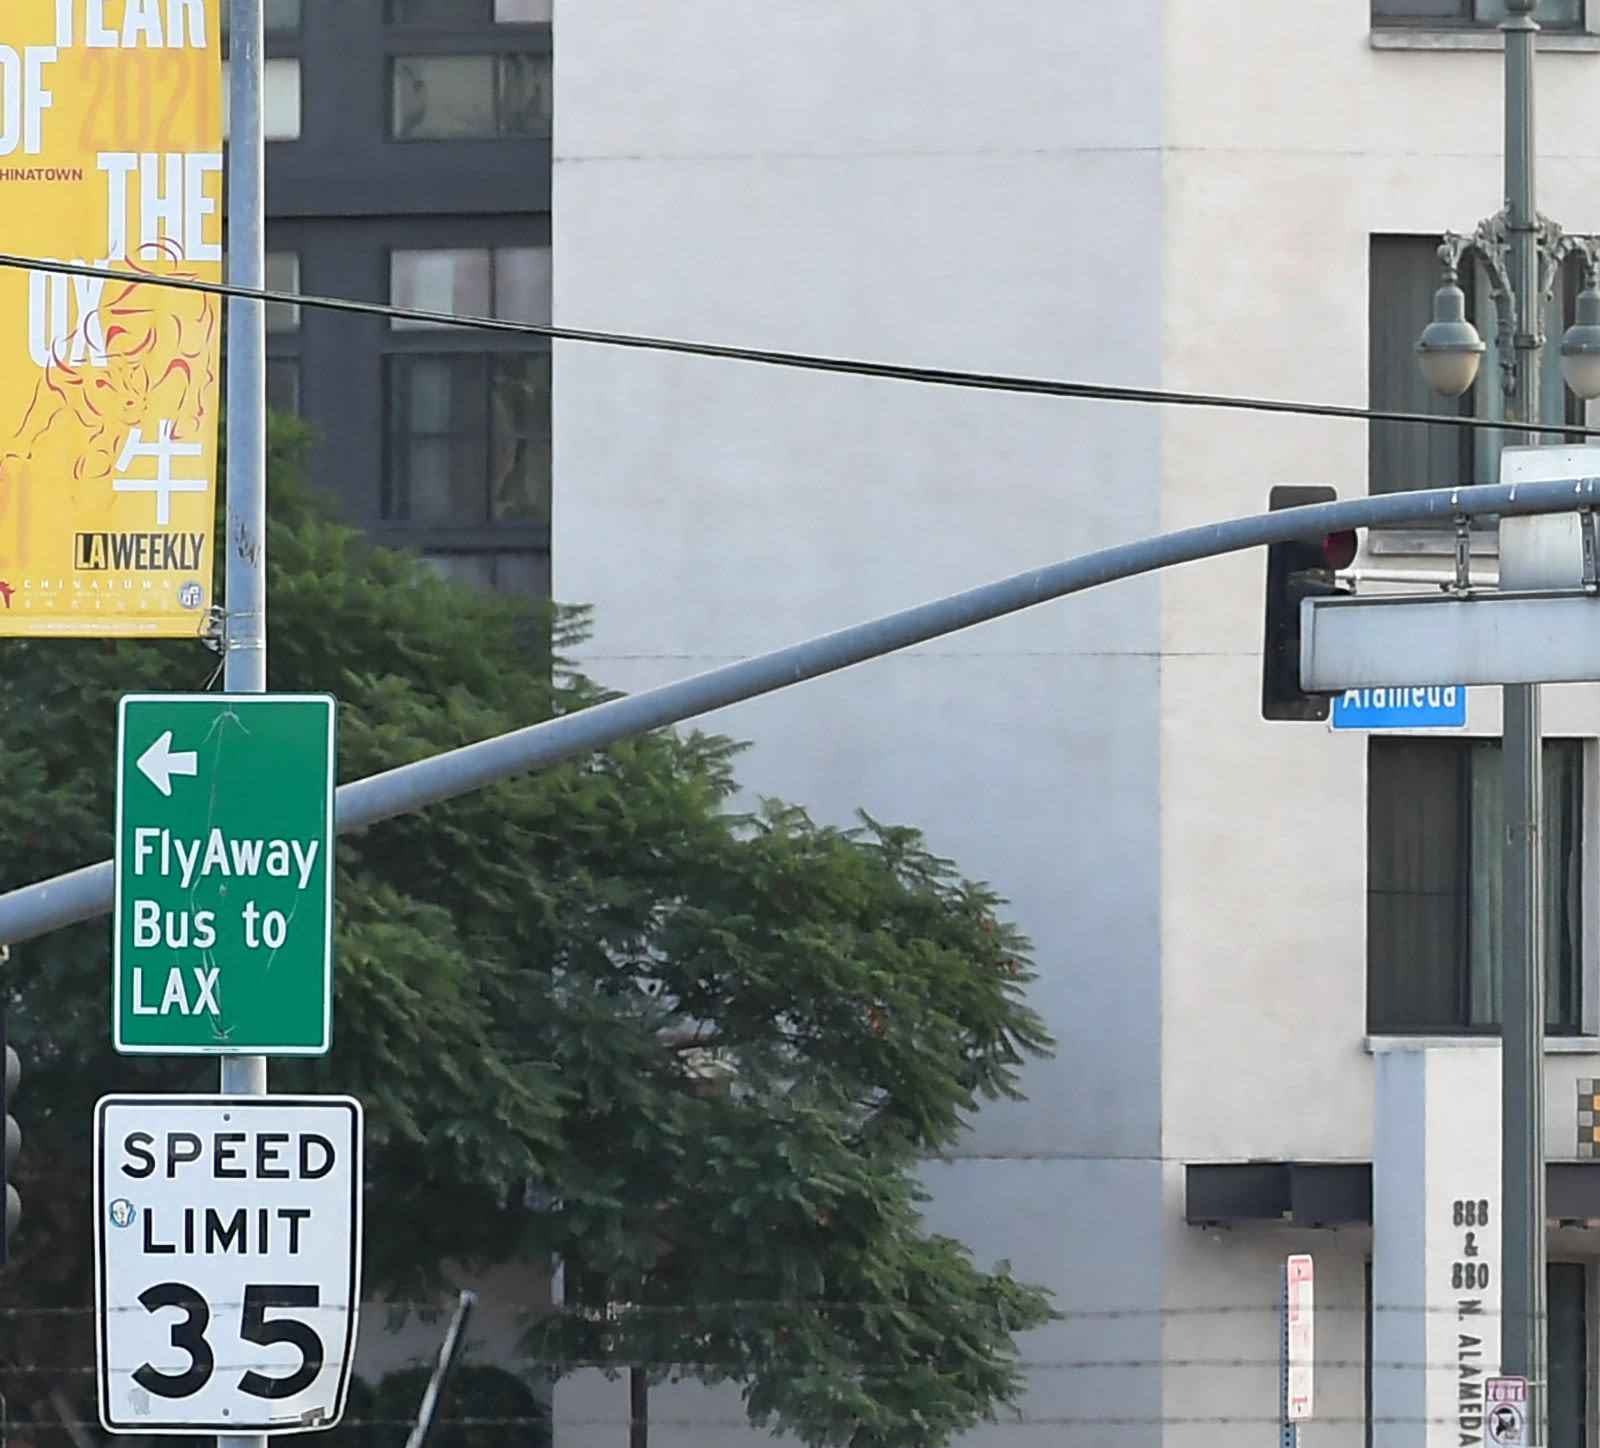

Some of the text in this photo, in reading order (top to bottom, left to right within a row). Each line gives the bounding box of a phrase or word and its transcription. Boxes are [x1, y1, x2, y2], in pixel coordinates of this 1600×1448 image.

[0, 168, 83, 181] HINATOWN
[96, 152, 223, 261] THE
[28, 258, 110, 367] OX
[112, 419, 208, 525] 牛
[111, 533, 205, 570] WEEKLY
[134, 827, 319, 889] FlyAway
[133, 900, 287, 949] Bus to
[132, 967, 220, 1015] LAX
[120, 1131, 336, 1180] SPEED
[143, 1207, 311, 1254] LIMIT
[131, 1282, 325, 1400] 35
[1458, 1333, 1482, 1448] ALAMEDA
